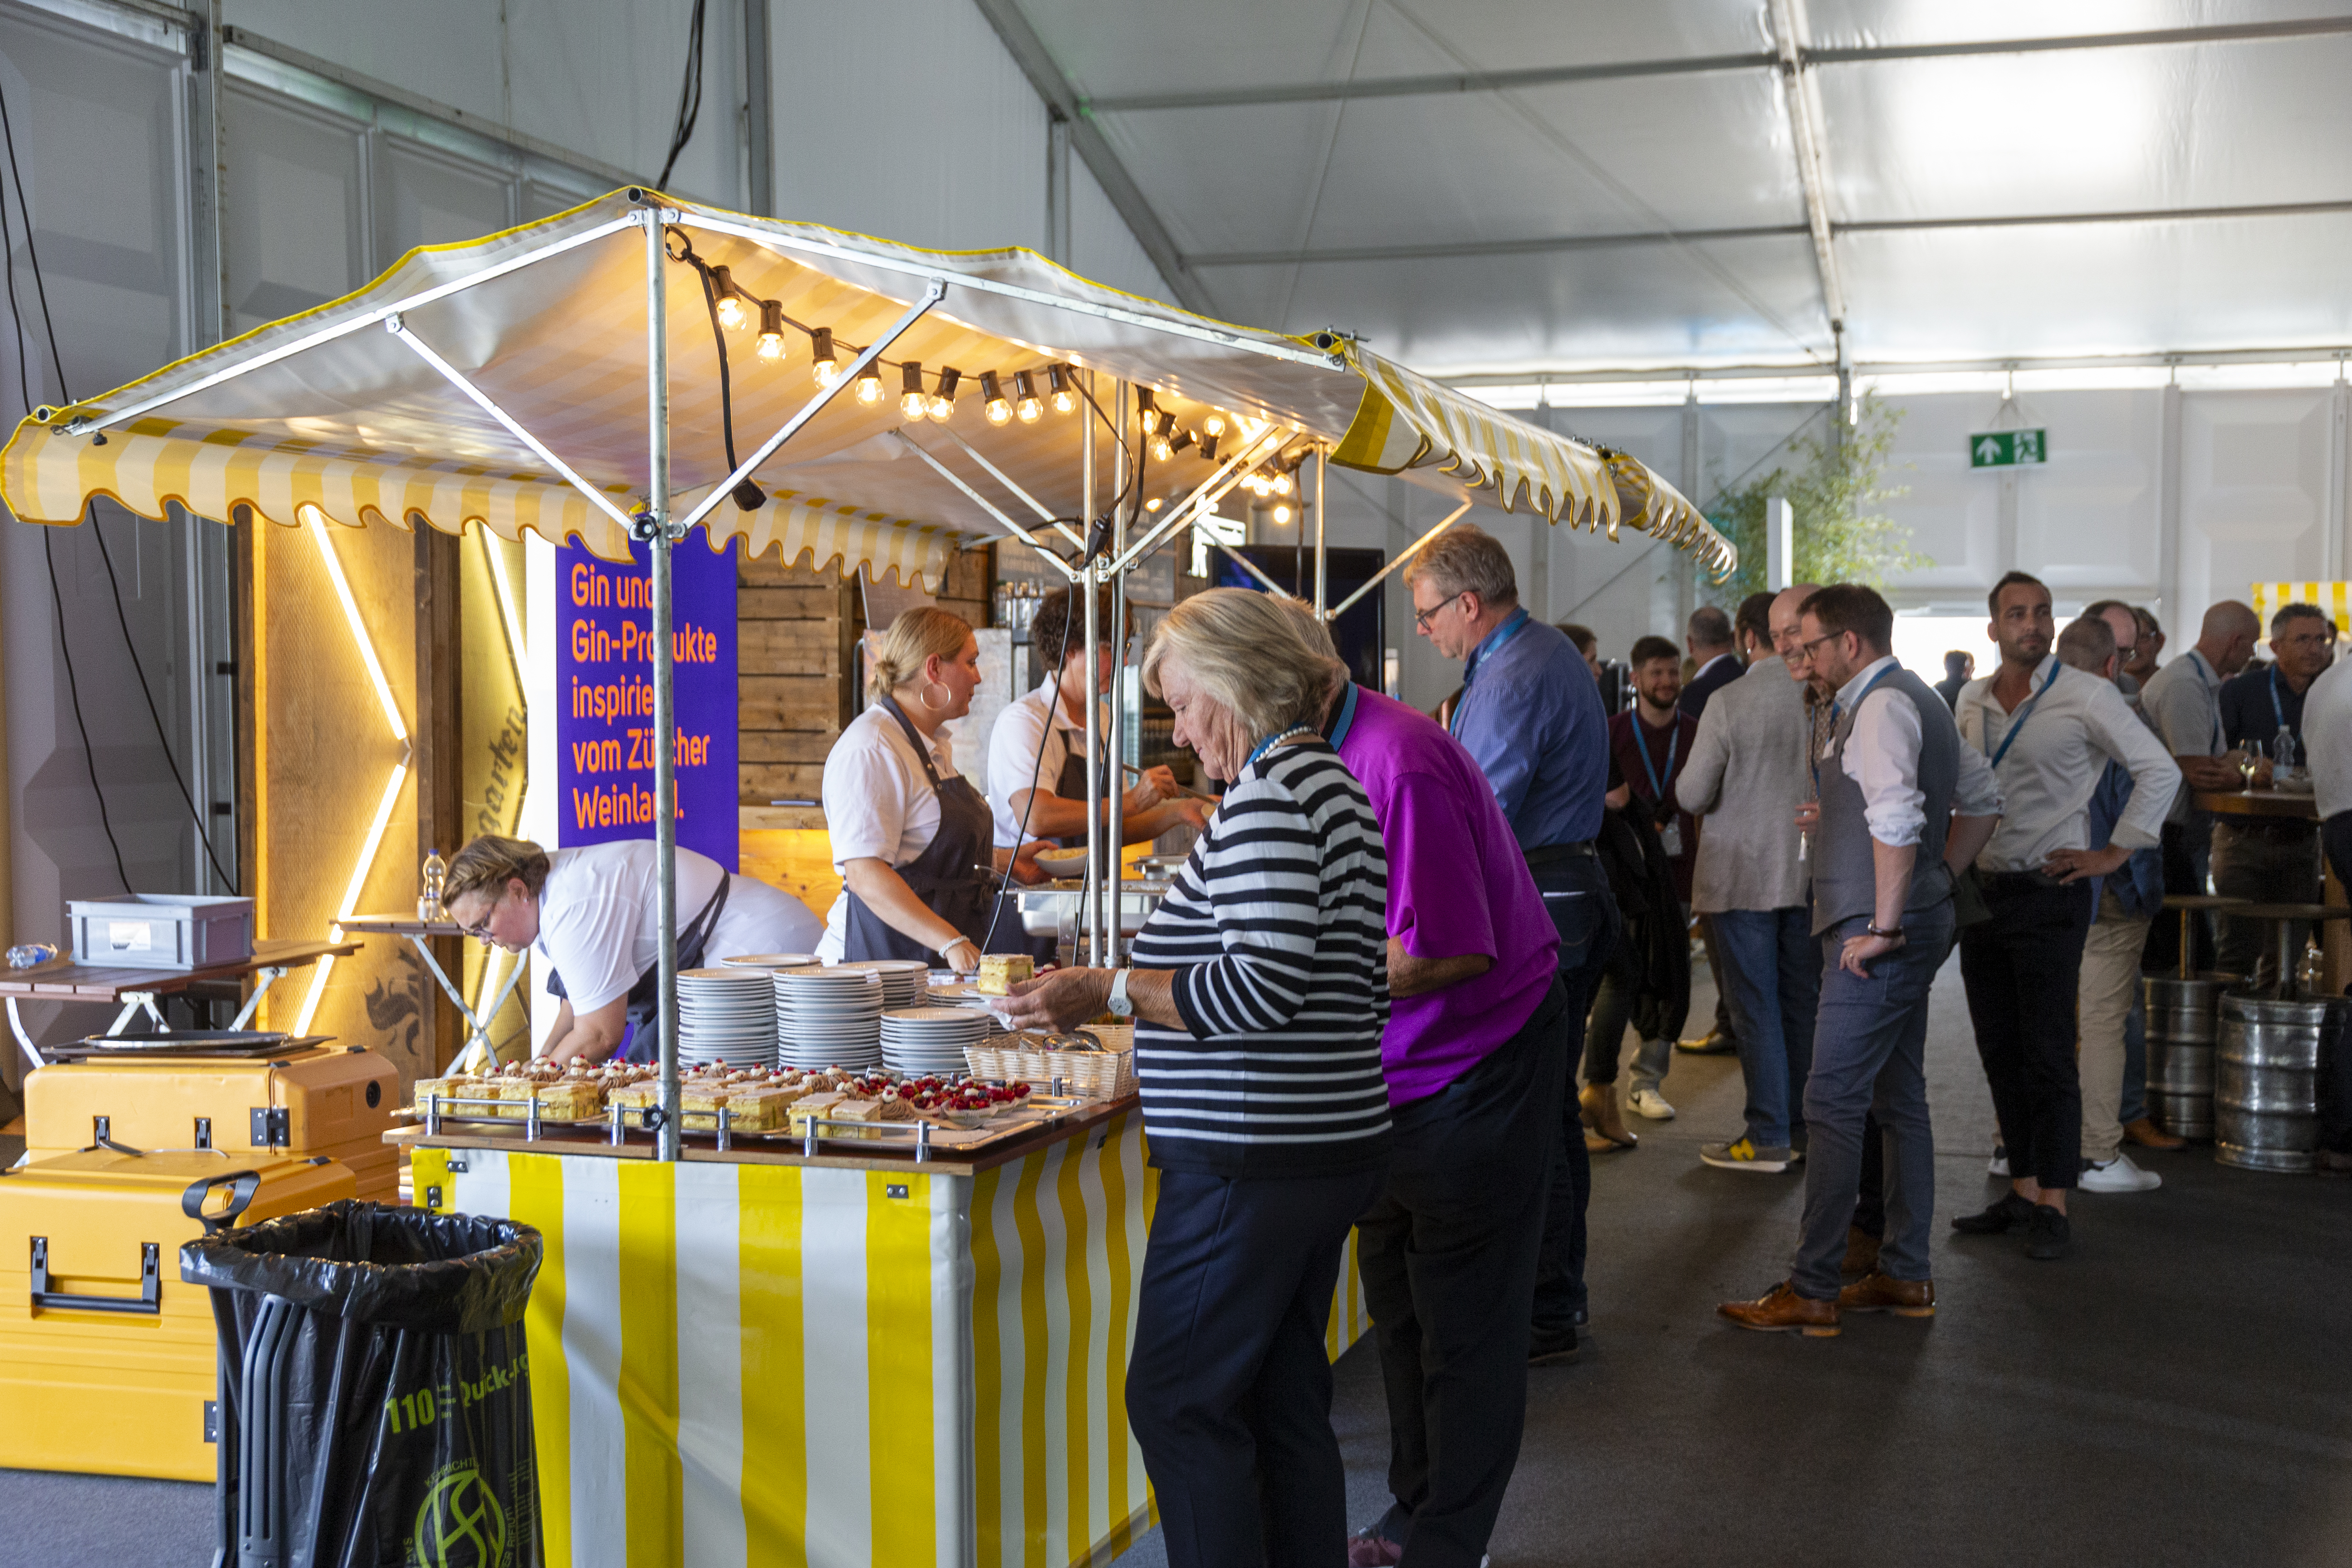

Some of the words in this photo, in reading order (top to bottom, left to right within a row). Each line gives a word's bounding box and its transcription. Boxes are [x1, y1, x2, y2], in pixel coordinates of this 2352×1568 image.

[572, 563, 610, 607] Gin
[572, 619, 717, 662] Gin-Proukte
[572, 675, 654, 725] inspirie
[472, 705, 525, 838] garten
[572, 740, 621, 774] vom
[627, 727, 710, 769] Züher
[386, 1388, 435, 1434] 110
